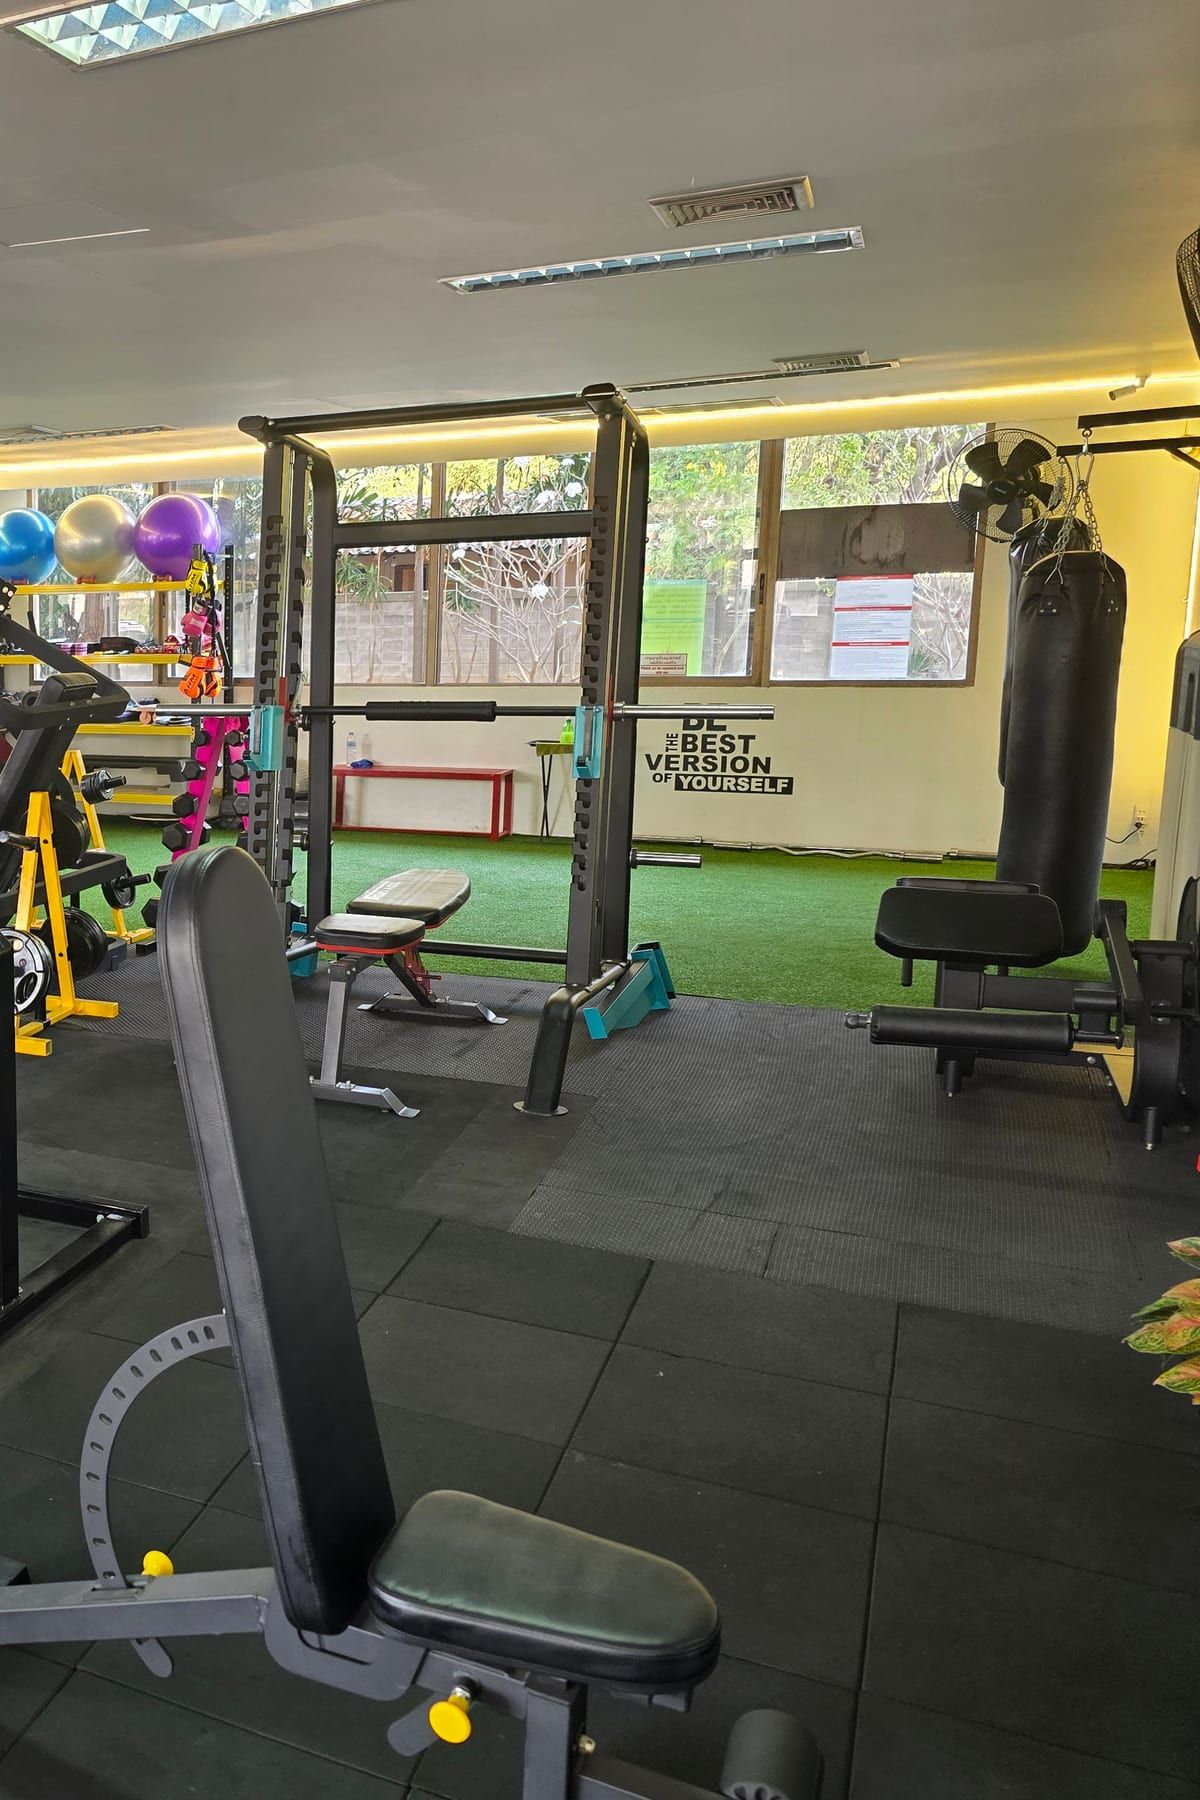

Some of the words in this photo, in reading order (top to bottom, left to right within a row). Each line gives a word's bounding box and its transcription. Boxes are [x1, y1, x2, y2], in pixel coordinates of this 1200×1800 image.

[665, 733, 678, 752] THE
[681, 733, 756, 754] BEST
[645, 754, 771, 774] VERSION
[652, 773, 672, 783] OF
[679, 775, 789, 793] YOURSELF
